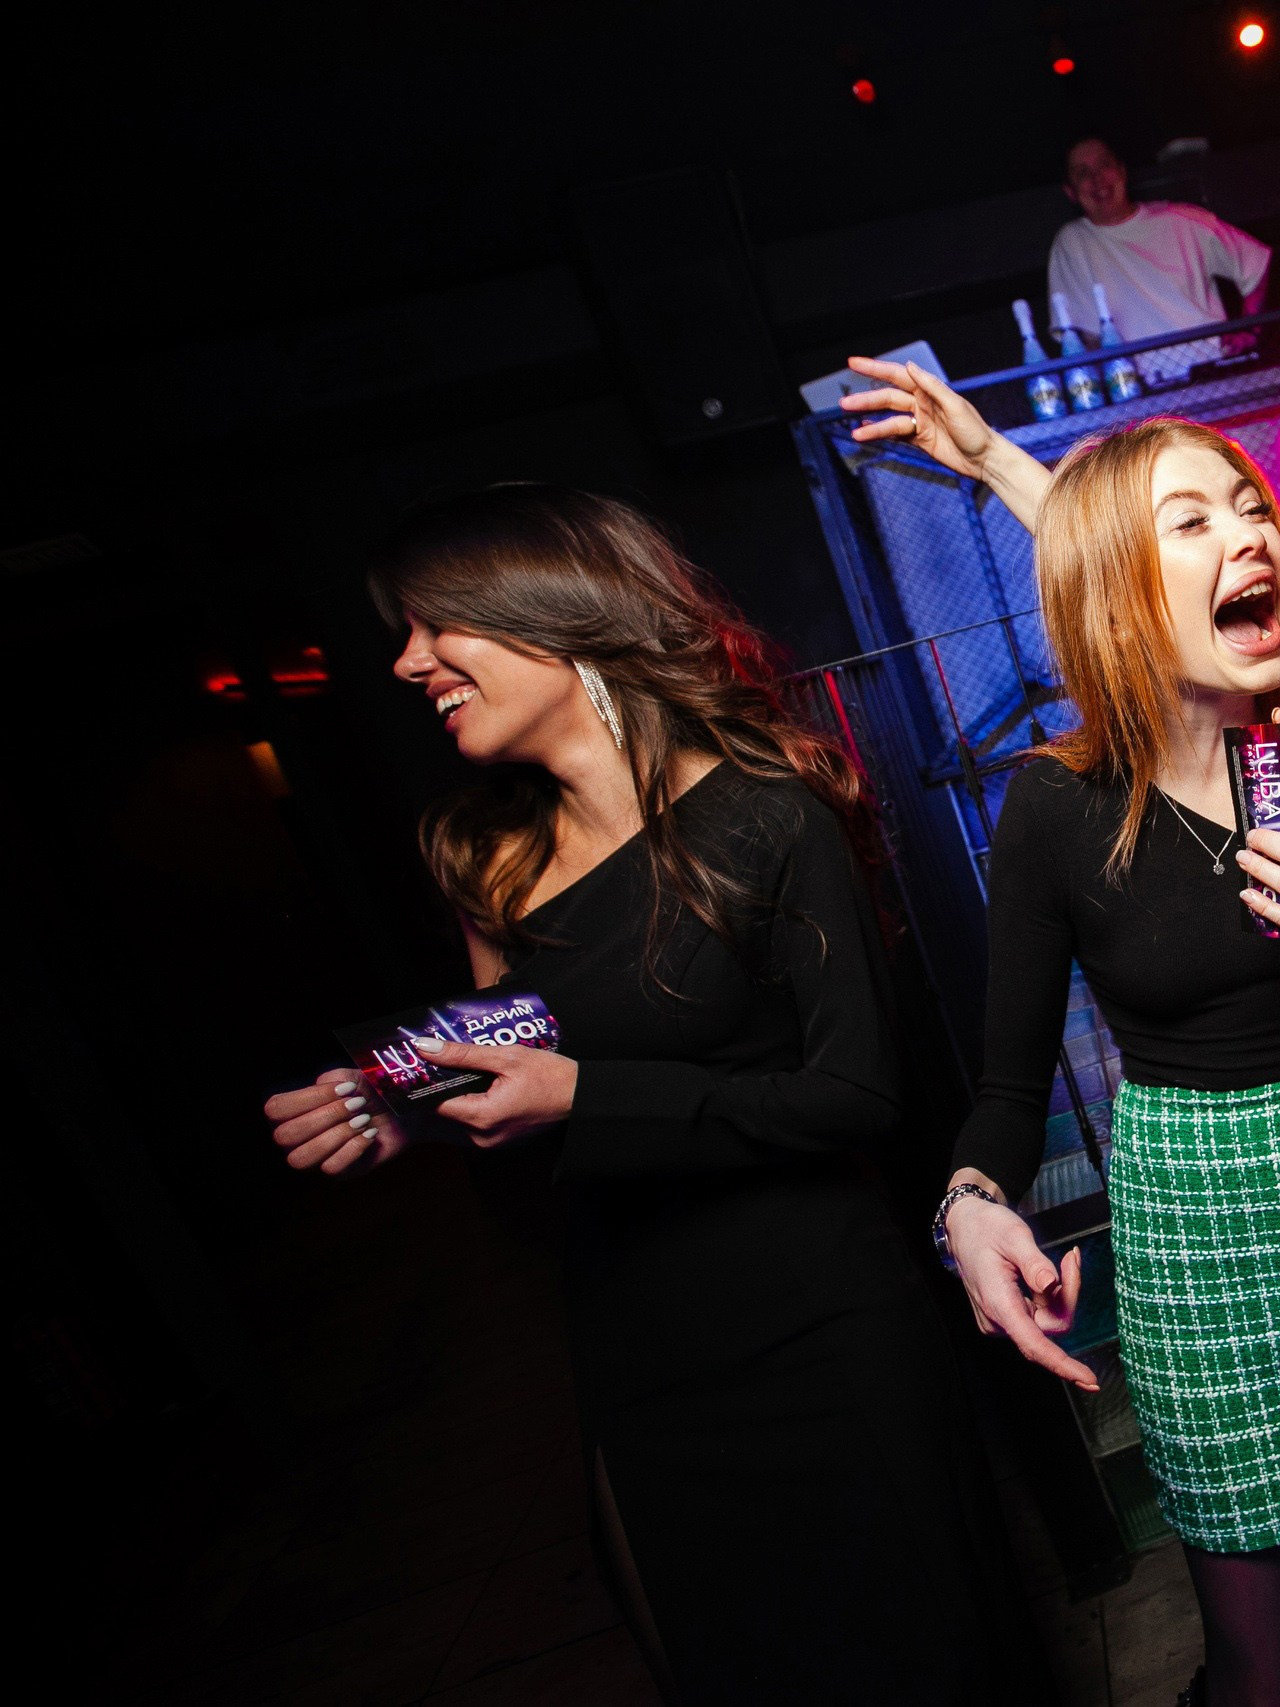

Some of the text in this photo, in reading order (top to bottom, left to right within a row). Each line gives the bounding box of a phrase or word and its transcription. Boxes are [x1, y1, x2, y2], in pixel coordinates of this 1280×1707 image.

[1246, 744, 1256, 780] PARTY
[465, 1003, 535, 1034] ДАРИМ
[372, 1031, 447, 1075] LU
[392, 1067, 428, 1084] PARTY
